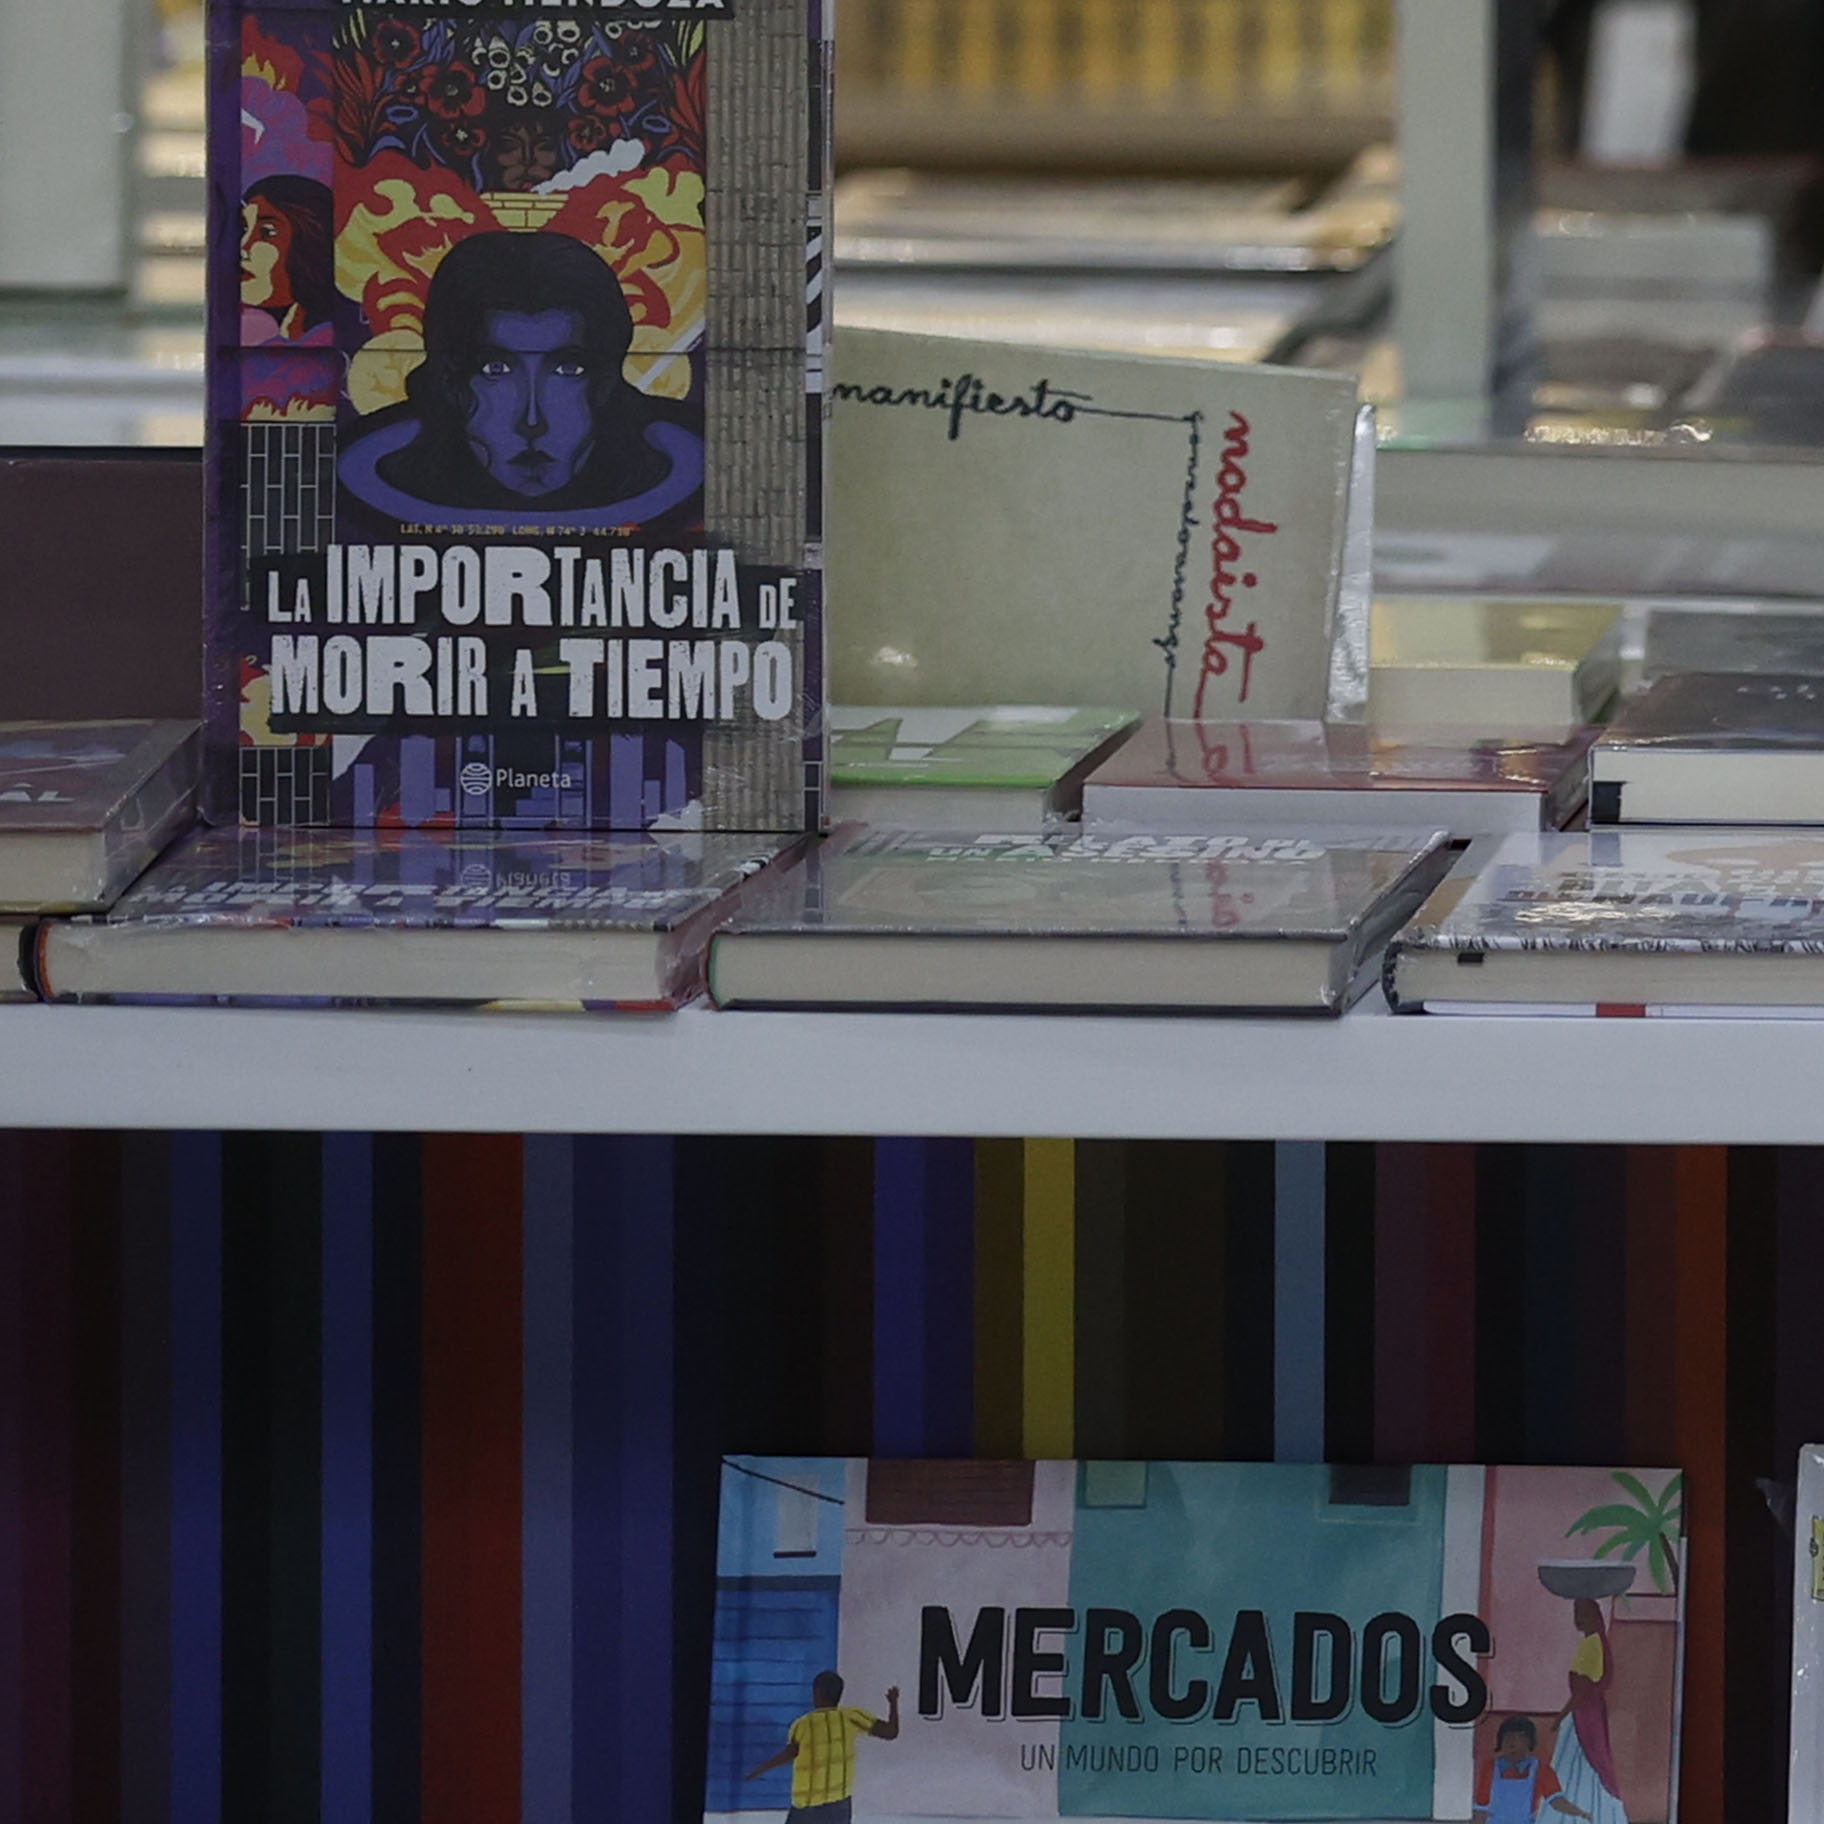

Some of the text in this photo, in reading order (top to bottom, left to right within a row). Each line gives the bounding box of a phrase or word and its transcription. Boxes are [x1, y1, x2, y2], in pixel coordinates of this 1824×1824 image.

[268, 543, 798, 631] LA IMPORTANCIA DE
[271, 634, 794, 721] MORIR A TIEMPO
[496, 768, 572, 789] Planeta
[916, 1605, 1493, 1727] MERCADOS
[1020, 1744, 1378, 1778] UN MUNDO POR DESCUBRIR
